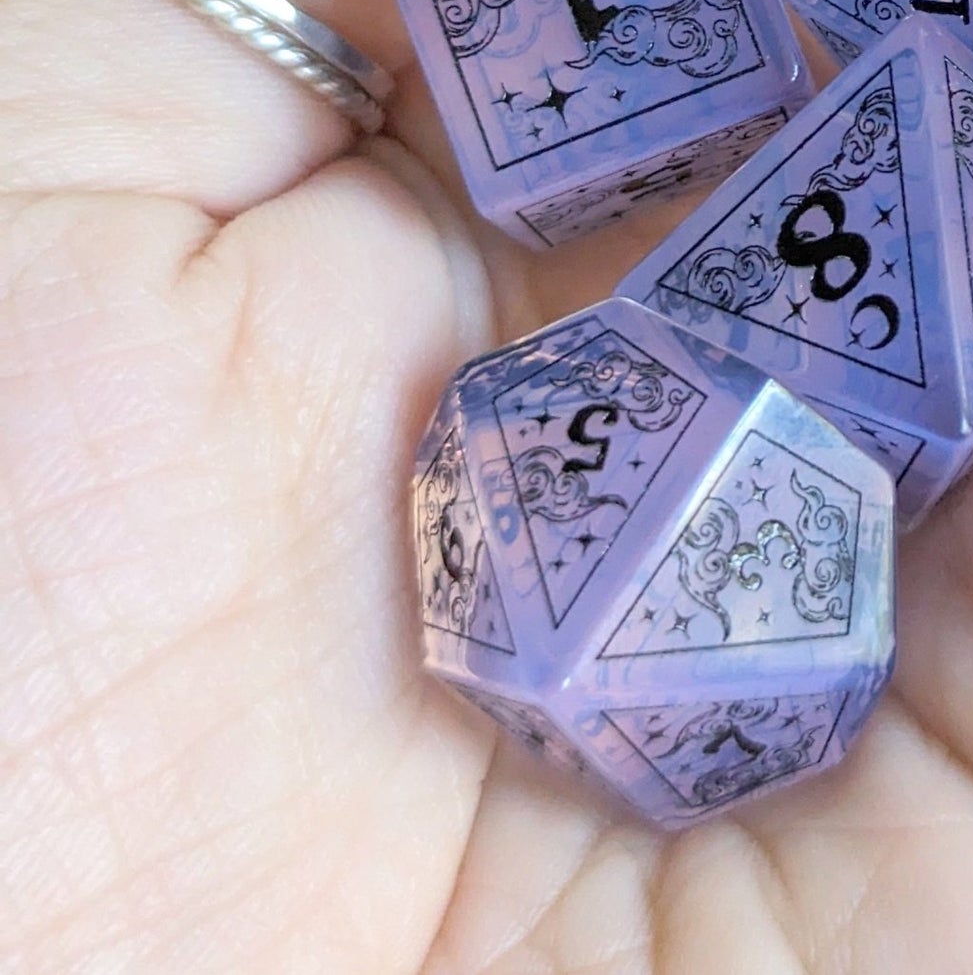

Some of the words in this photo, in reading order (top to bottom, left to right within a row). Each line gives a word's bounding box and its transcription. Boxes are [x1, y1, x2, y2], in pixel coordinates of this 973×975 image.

[777, 191, 872, 301] 8
[562, 403, 618, 472] 5
[729, 520, 799, 591] 3
